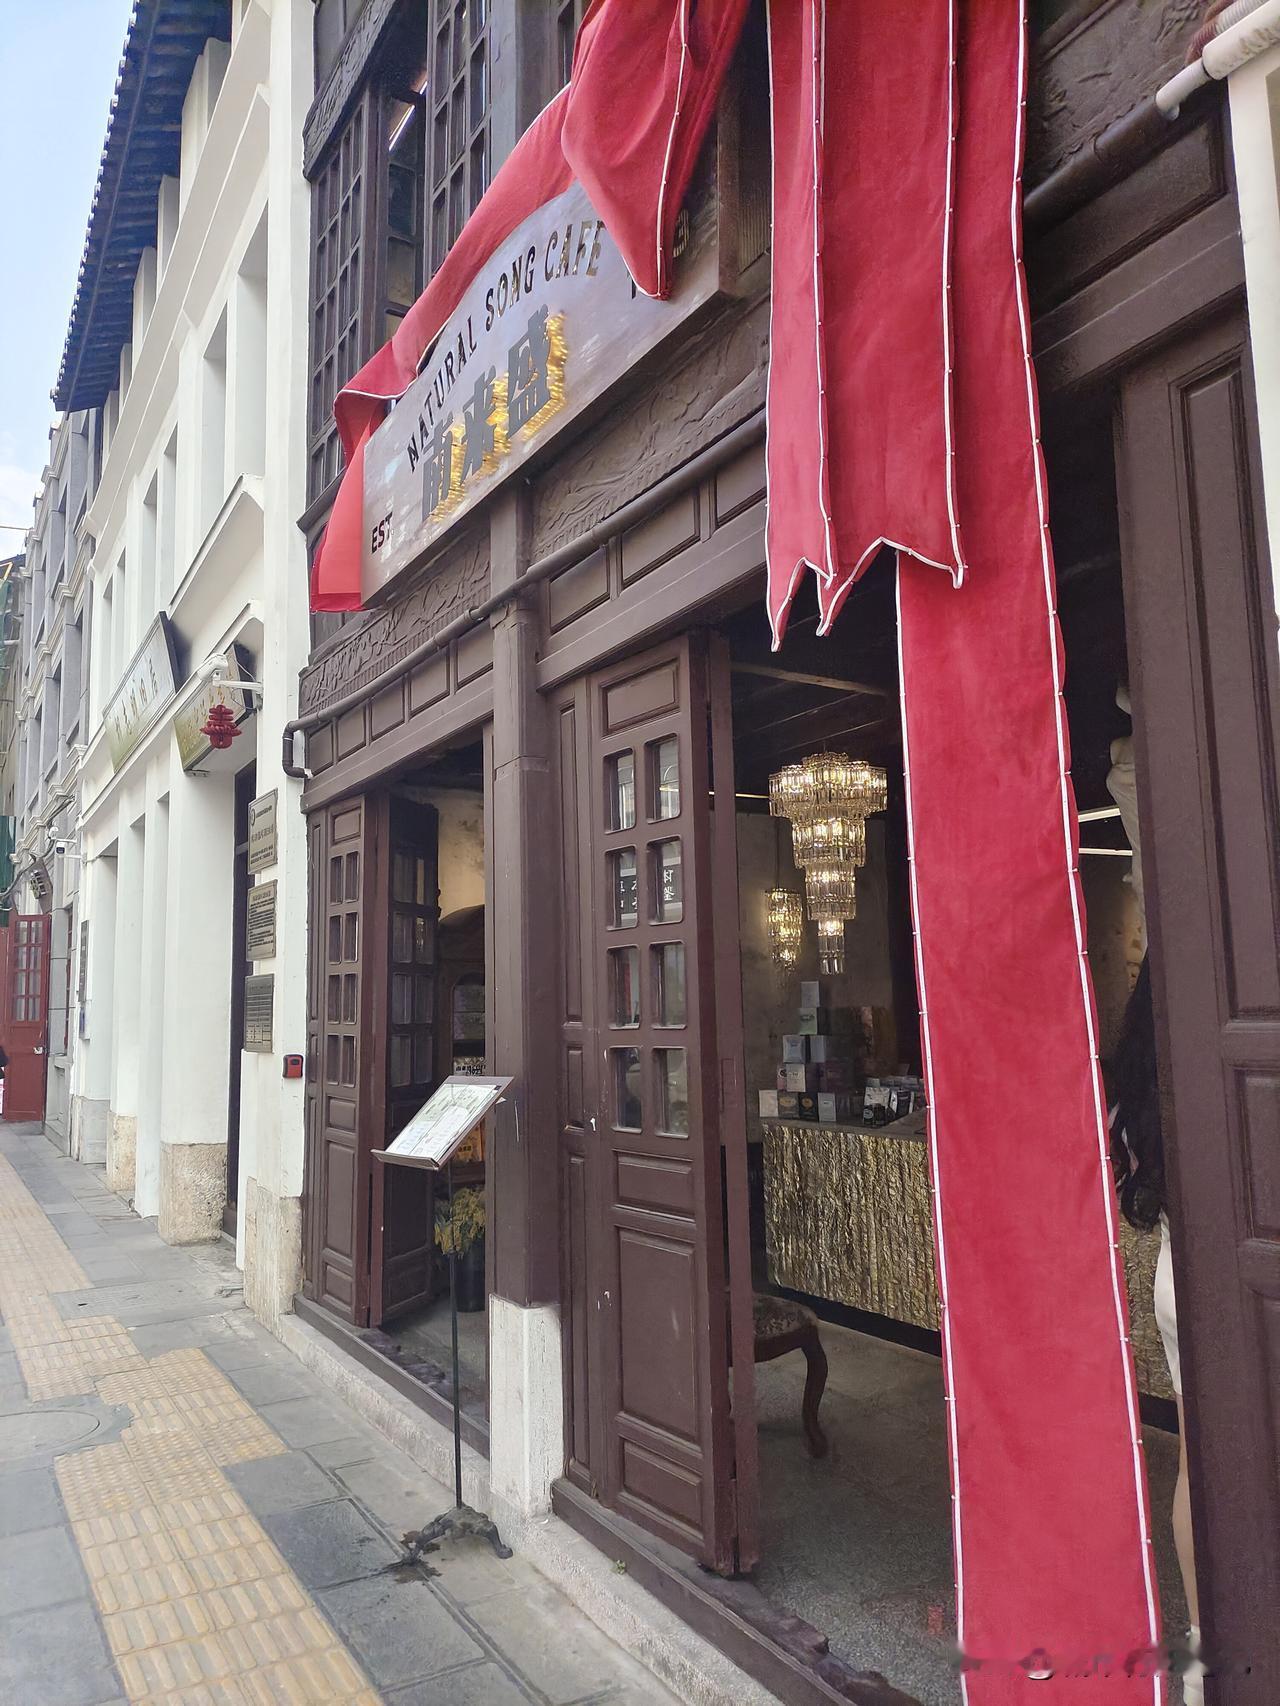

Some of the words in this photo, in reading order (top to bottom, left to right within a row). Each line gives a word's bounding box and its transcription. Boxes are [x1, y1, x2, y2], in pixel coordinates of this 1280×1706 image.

[407, 315, 478, 473] NATURAL
[485, 245, 536, 332] SONG
[543, 219, 607, 282] CAFE
